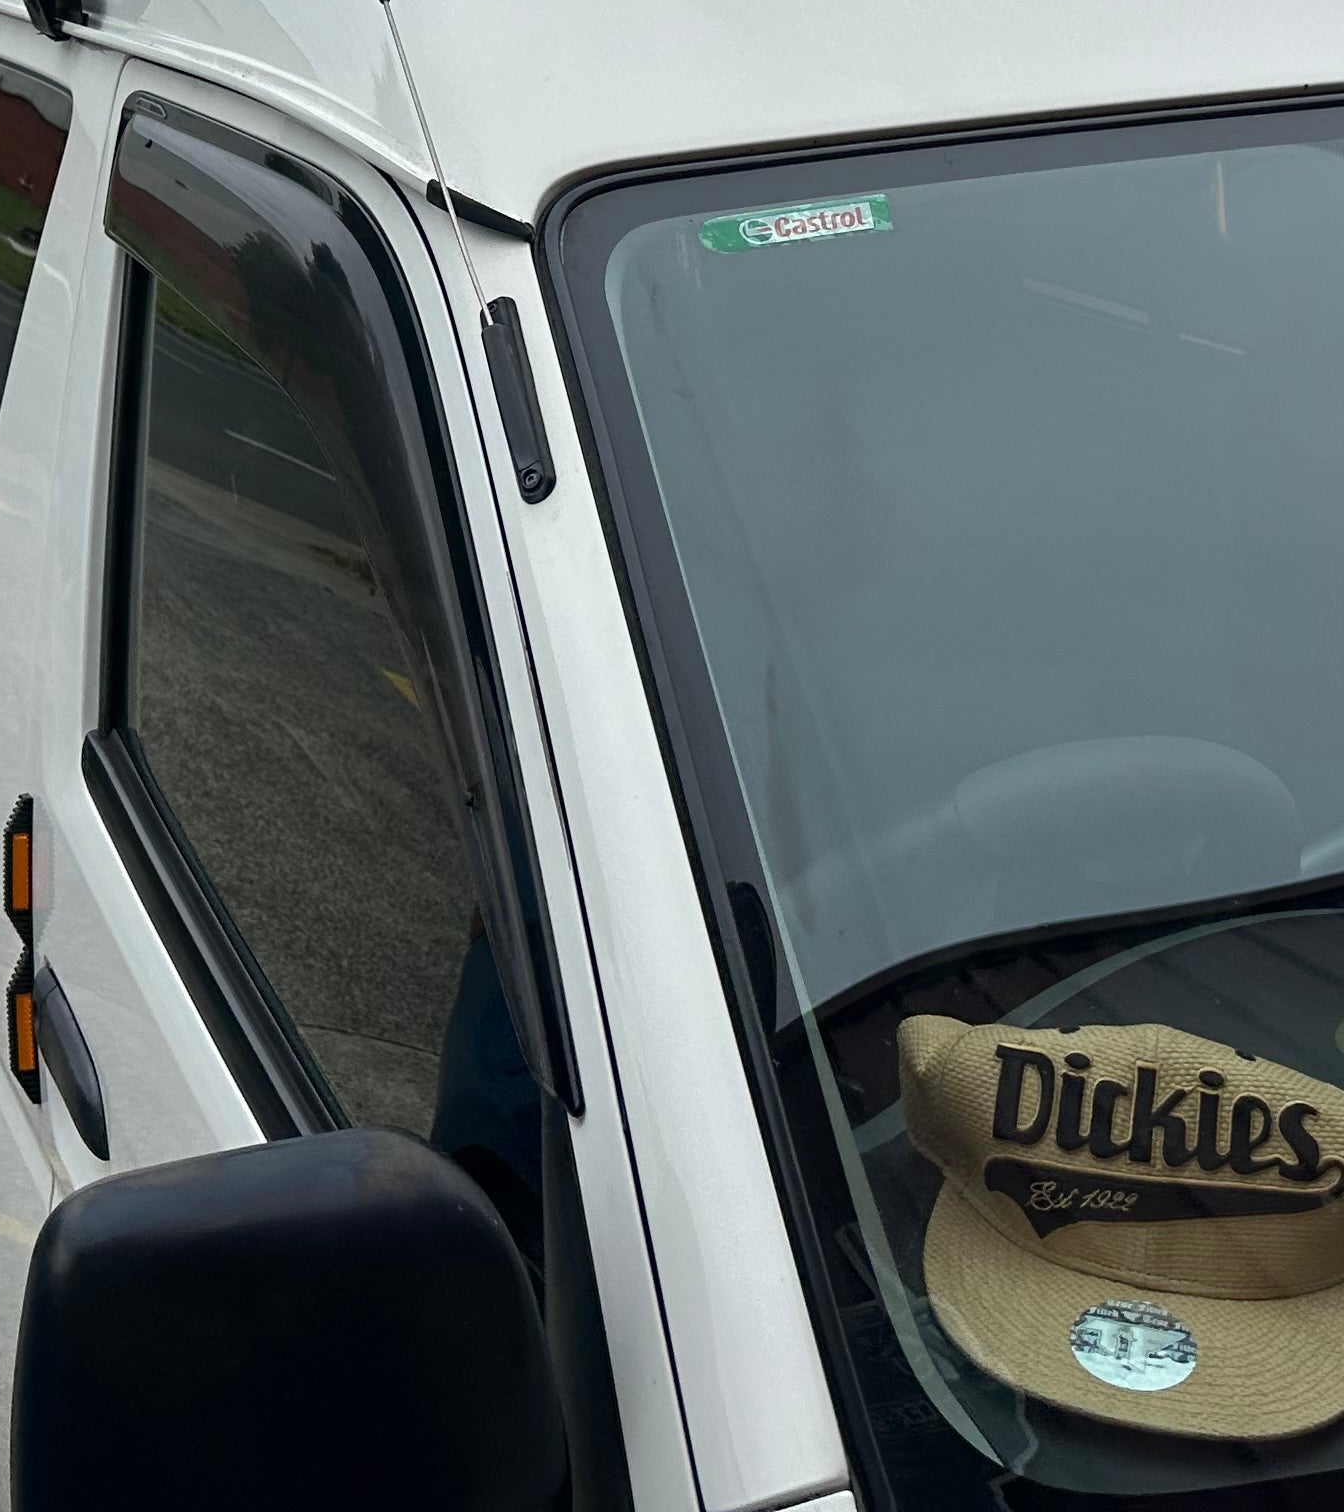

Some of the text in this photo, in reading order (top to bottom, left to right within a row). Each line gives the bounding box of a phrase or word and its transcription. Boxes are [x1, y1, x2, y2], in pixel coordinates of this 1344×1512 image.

[774, 206, 867, 239] Castrol
[992, 1043, 1322, 1181] Dickies
[1025, 1181, 1079, 1210] Est
